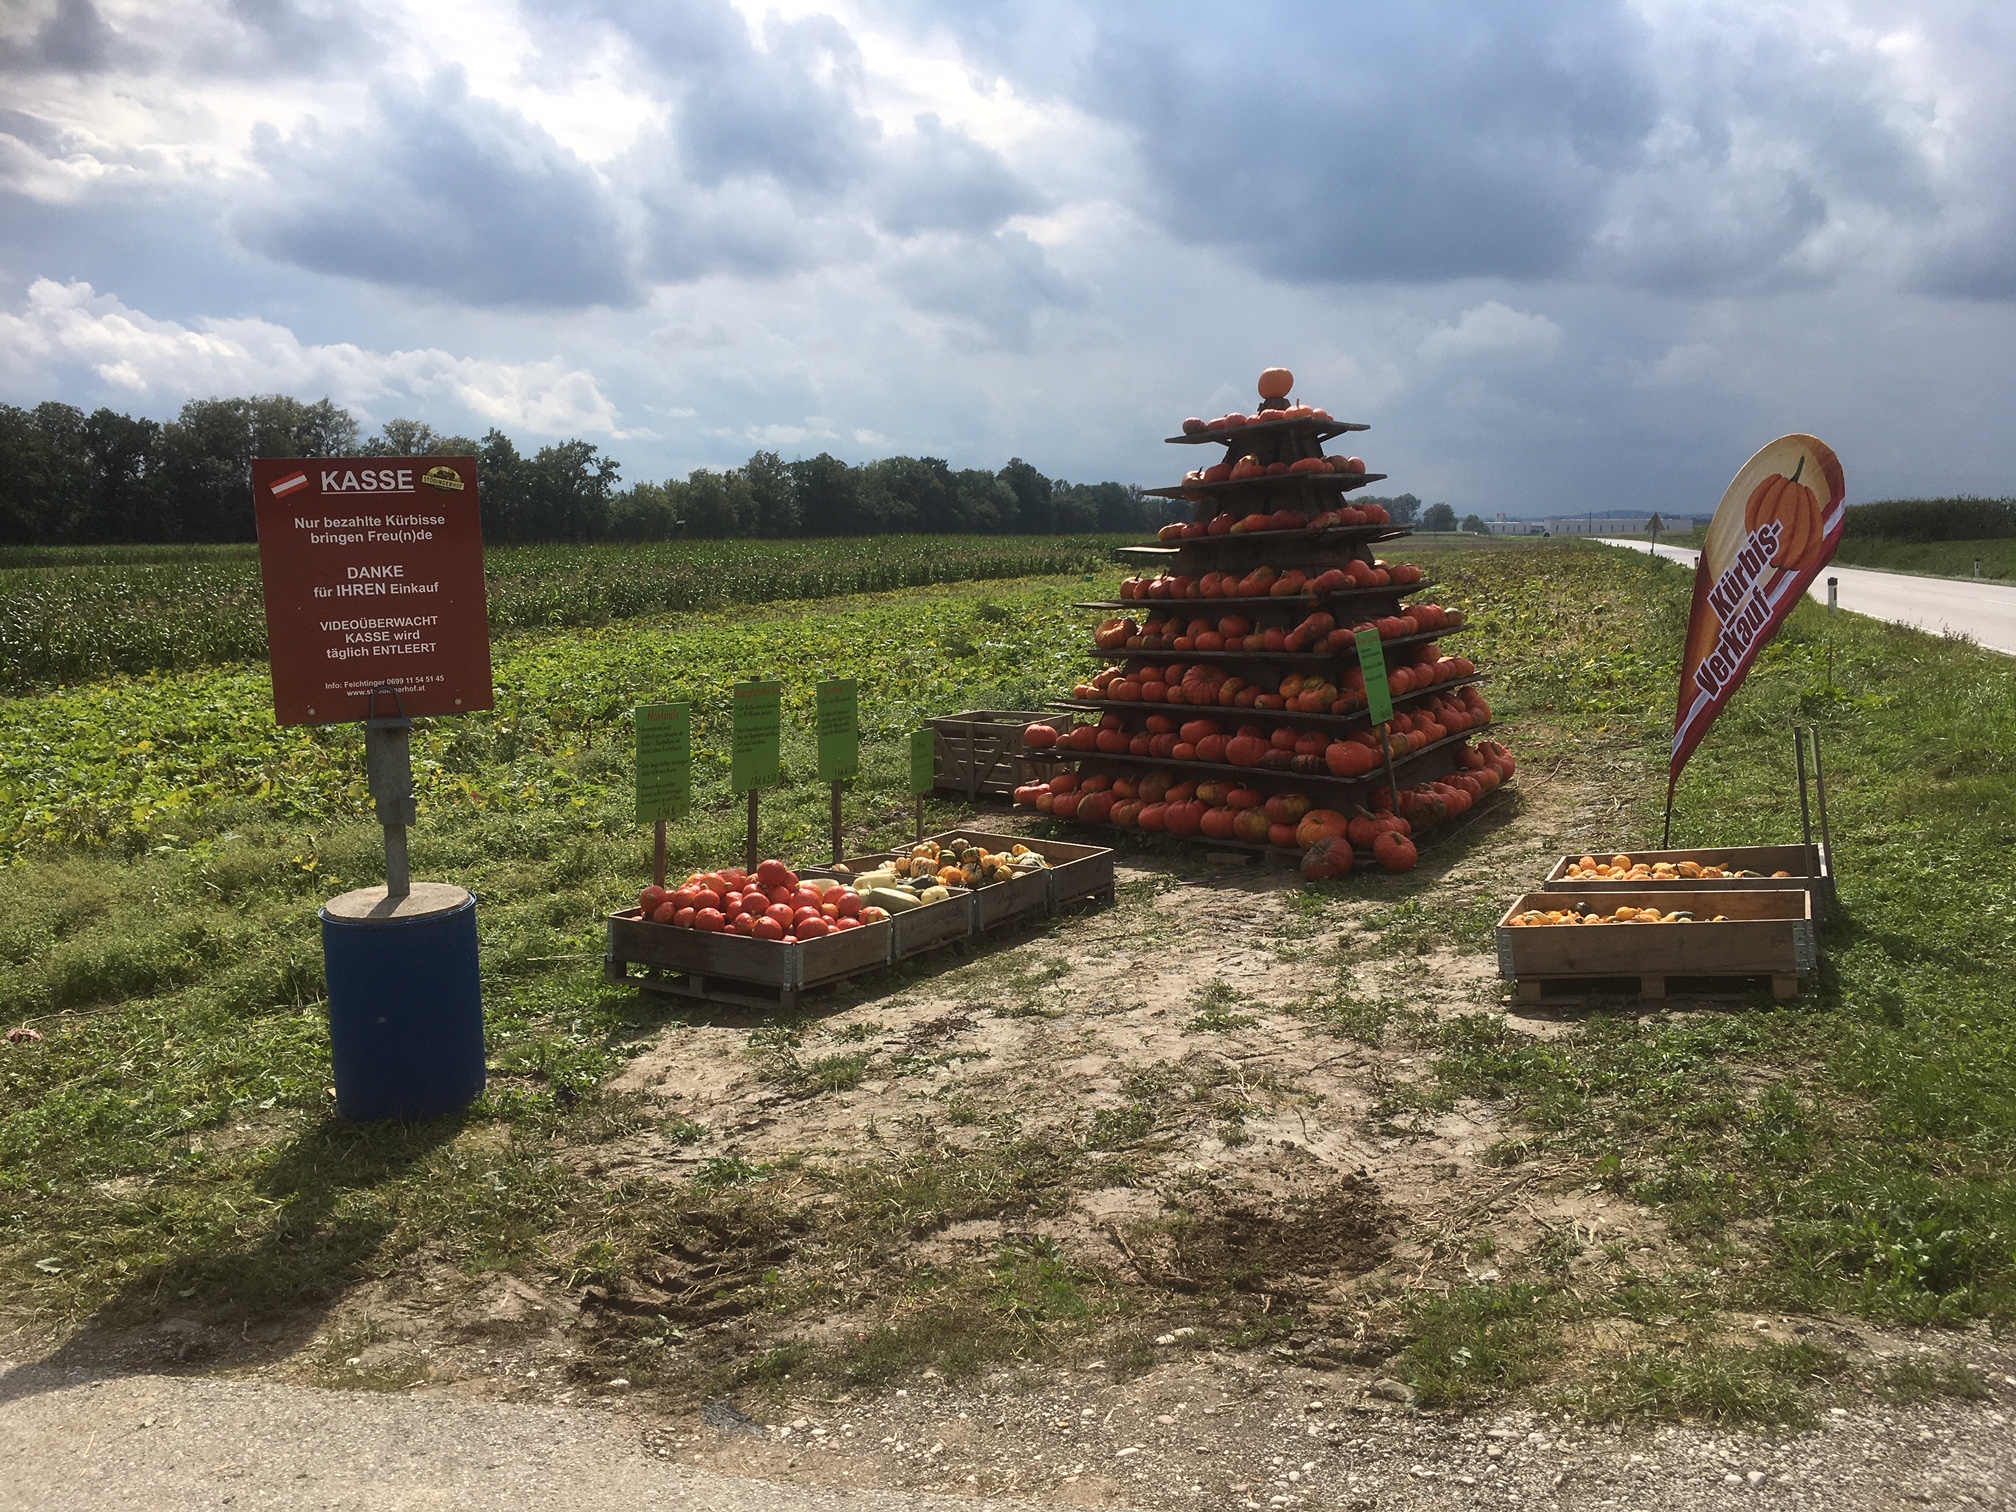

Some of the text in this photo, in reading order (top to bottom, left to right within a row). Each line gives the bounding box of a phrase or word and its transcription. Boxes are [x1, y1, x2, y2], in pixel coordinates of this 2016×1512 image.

[320, 469, 414, 492] KASSE
[294, 514, 446, 529] Nur bezahlte Kürbisse
[310, 529, 433, 546] bringen Freu(n)de
[347, 565, 404, 580] DANKE
[1708, 520, 1783, 624] Kürbis-
[313, 581, 439, 598] für IHREN Einkauf
[319, 615, 438, 631] VIDEOÜBERWACHT
[345, 629, 421, 644] KASSE wird
[1695, 584, 1772, 699] Verkauf
[326, 642, 437, 660] täglich ENTLEERT
[325, 682, 342, 690] Info:
[344, 679, 386, 689] Feichtinger
[386, 677, 404, 685] 0699
[415, 676, 425, 684] 54
[425, 675, 434, 683] 51
[435, 674, 445, 682] 45
